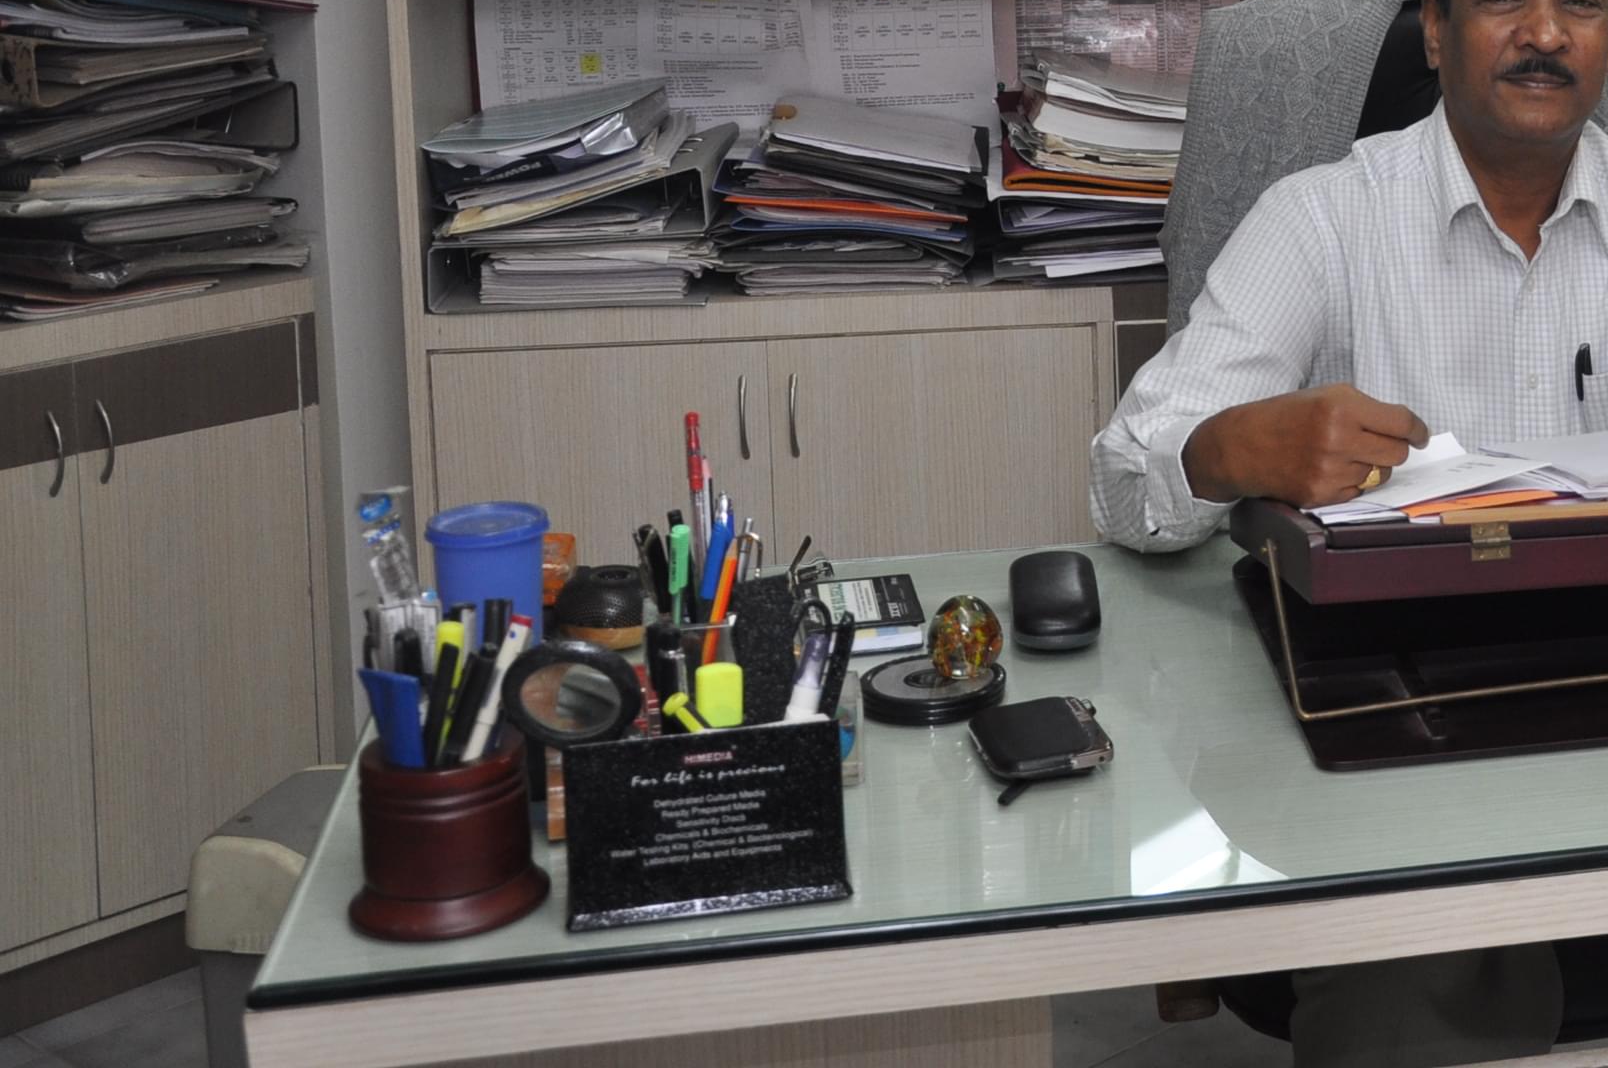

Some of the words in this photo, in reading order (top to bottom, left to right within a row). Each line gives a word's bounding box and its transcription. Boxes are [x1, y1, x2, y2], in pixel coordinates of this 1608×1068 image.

[683, 750, 733, 764] HIMEDIA
[631, 775, 659, 787] For
[664, 770, 693, 784] life
[698, 771, 714, 780] is
[717, 764, 786, 780] precious
[653, 795, 705, 809] Dehydrated
[706, 792, 737, 803] Culture
[739, 789, 766, 799] Media
[661, 809, 690, 820] Ready
[691, 804, 732, 816] Prepared
[733, 801, 760, 810] Media
[676, 816, 720, 829] Sensitivity
[654, 830, 701, 843] Chemicals
[711, 823, 769, 836] Biochemicals
[610, 848, 637, 858] Water
[639, 843, 671, 855] Testing
[671, 842, 689, 851] Kits
[643, 854, 690, 867] Laboratory
[692, 850, 712, 860] Aids
[713, 848, 730, 858] and
[731, 843, 783, 856] Equipments
